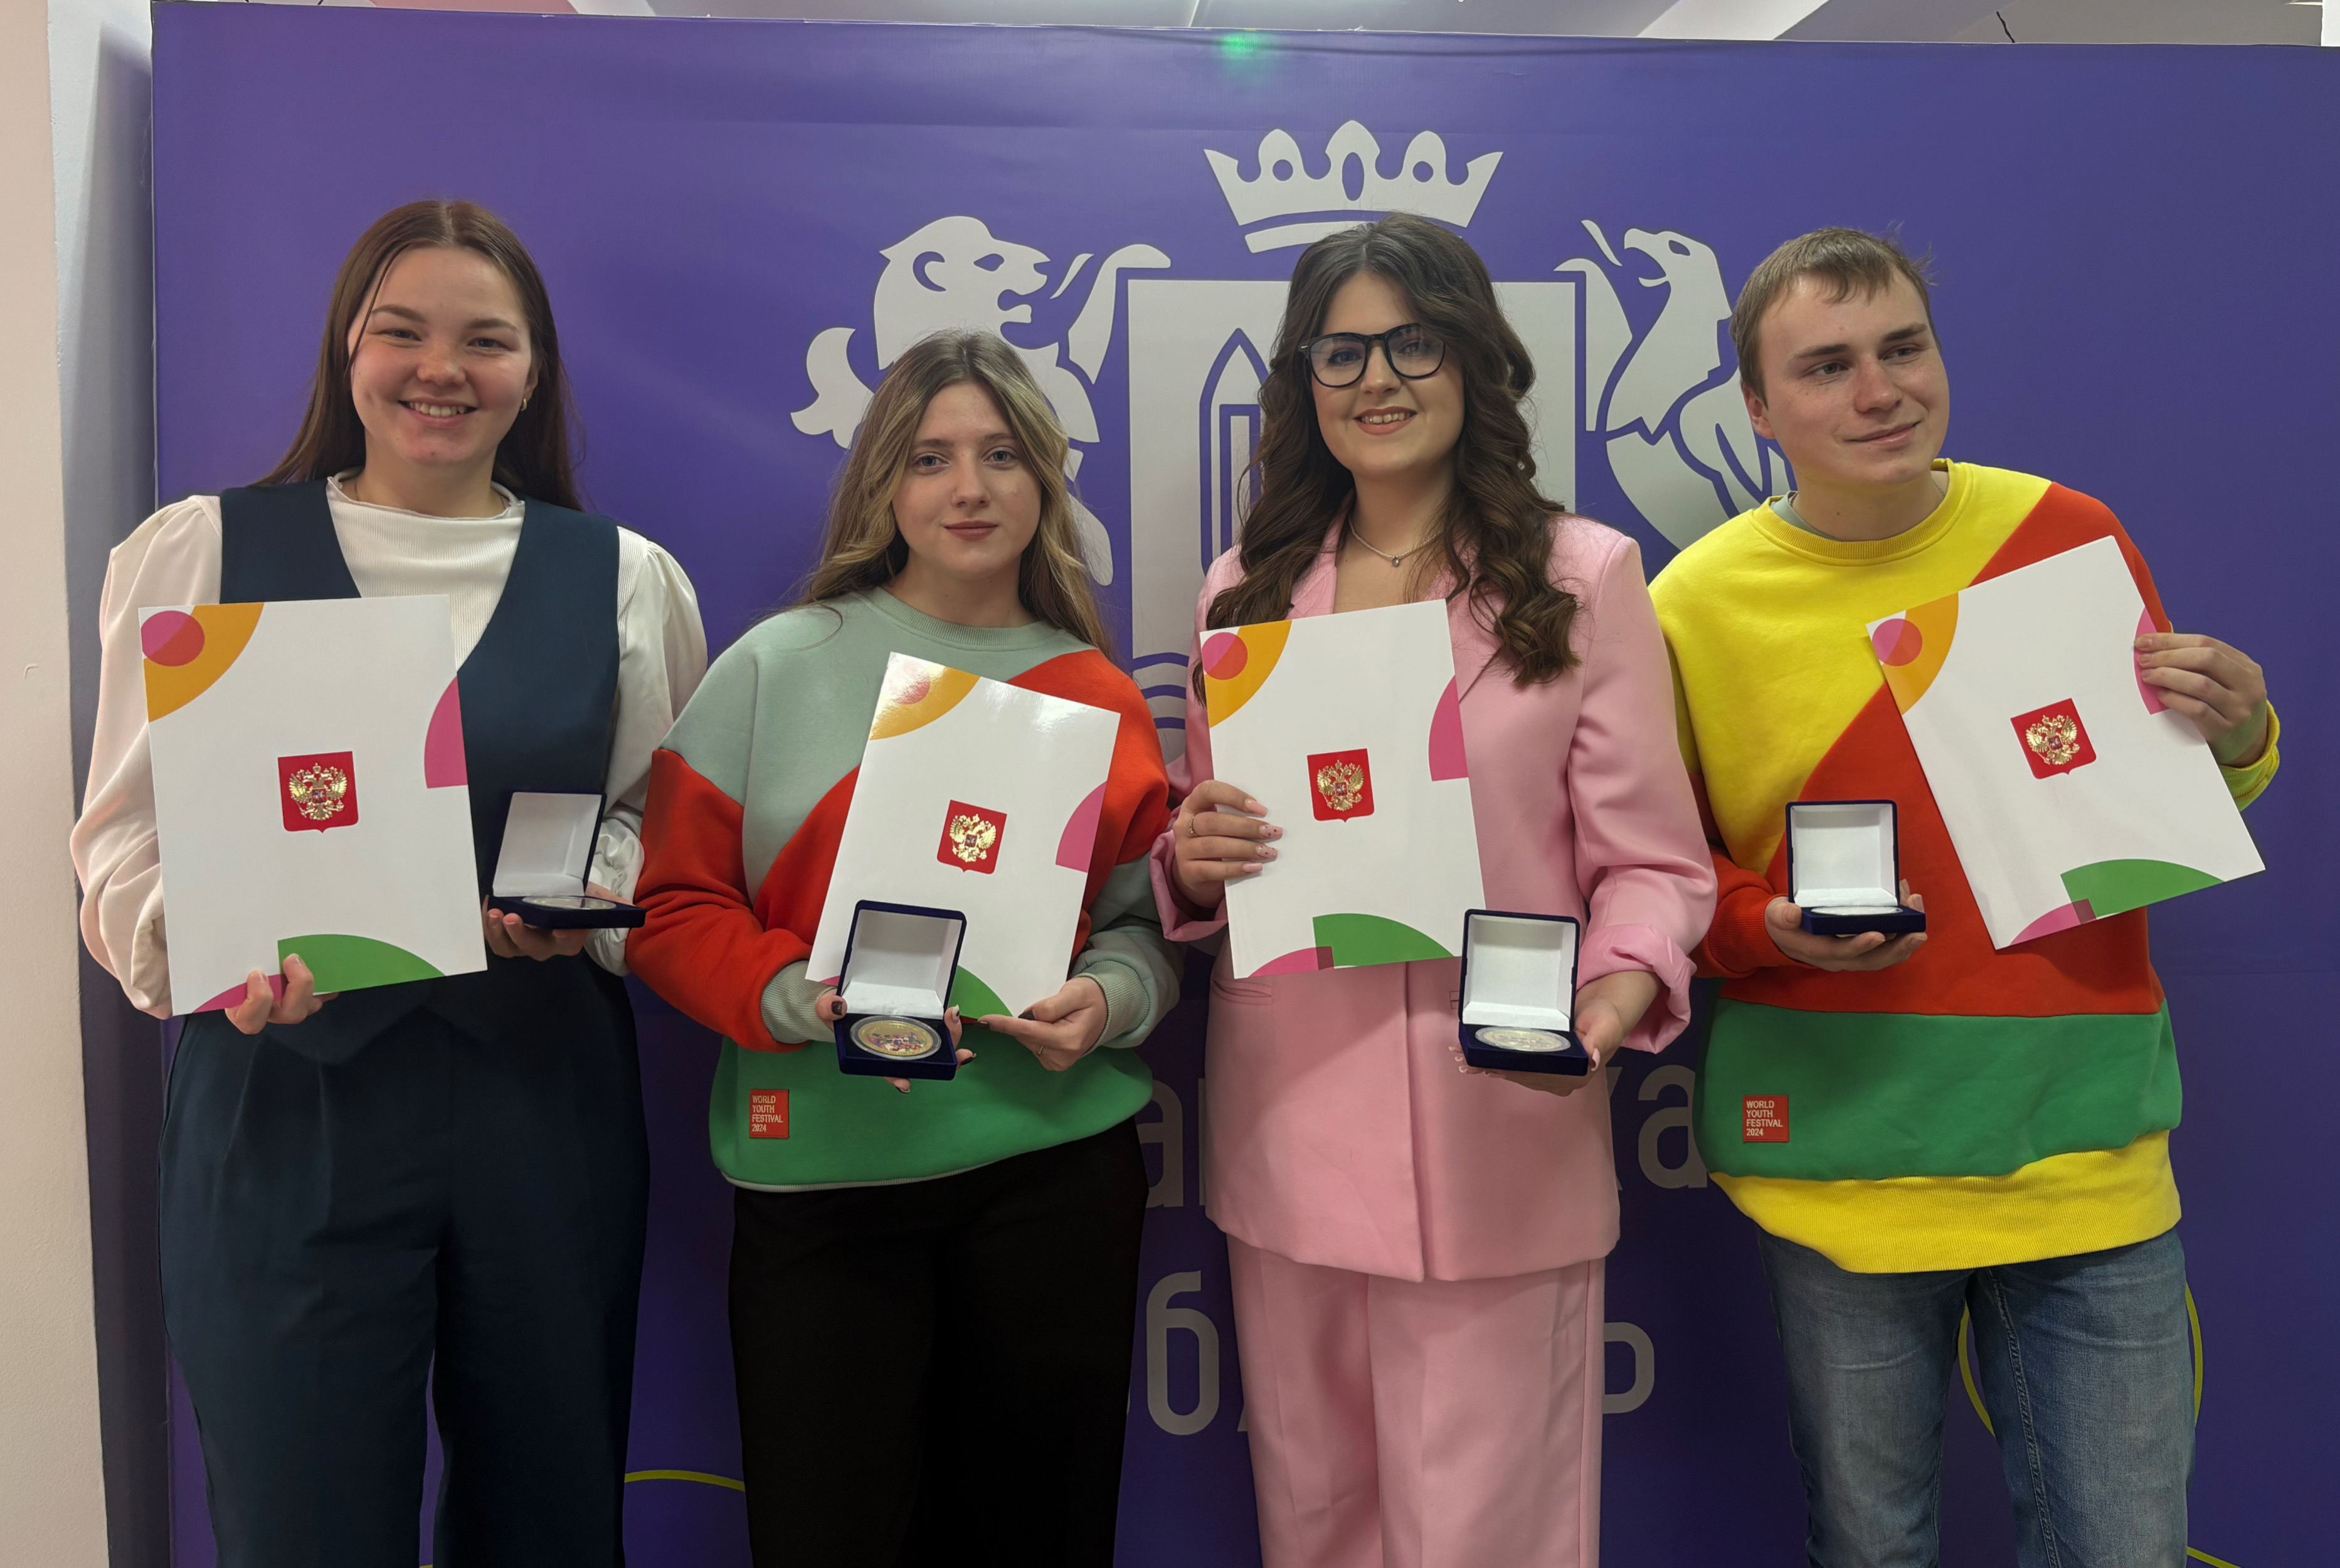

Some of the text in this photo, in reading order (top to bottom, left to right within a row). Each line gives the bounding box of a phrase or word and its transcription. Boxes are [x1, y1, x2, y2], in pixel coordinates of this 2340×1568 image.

[753, 1095, 776, 1104] WORLD
[753, 1104, 775, 1113] YOUTH
[1746, 1100, 1774, 1109] WORLD
[752, 1114, 783, 1123] FESTIVAL
[1746, 1110, 1773, 1118] YOUTH
[752, 1123, 766, 1132] 2024
[1746, 1119, 1783, 1127] FESTIVAL
[1746, 1128, 1764, 1136] 2024
